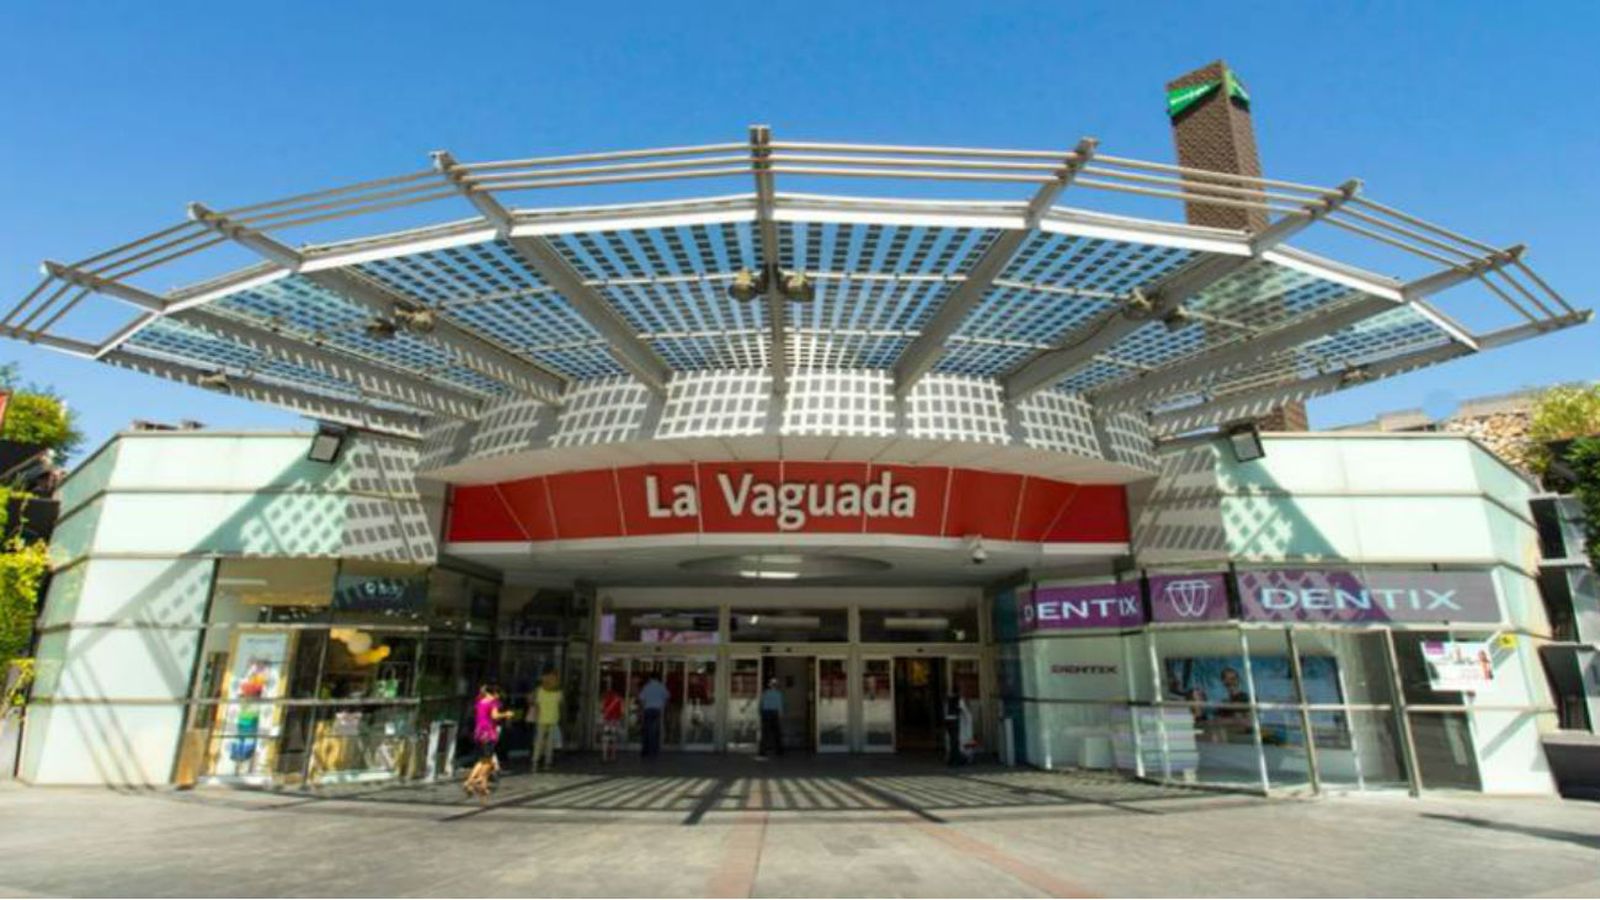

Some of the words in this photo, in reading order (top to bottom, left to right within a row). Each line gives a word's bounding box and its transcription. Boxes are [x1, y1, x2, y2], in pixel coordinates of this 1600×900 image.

[646, 475, 697, 518] La
[717, 471, 917, 531] Vaguada
[1023, 595, 1138, 622] DENTIX
[1261, 587, 1462, 610] DENTIX
